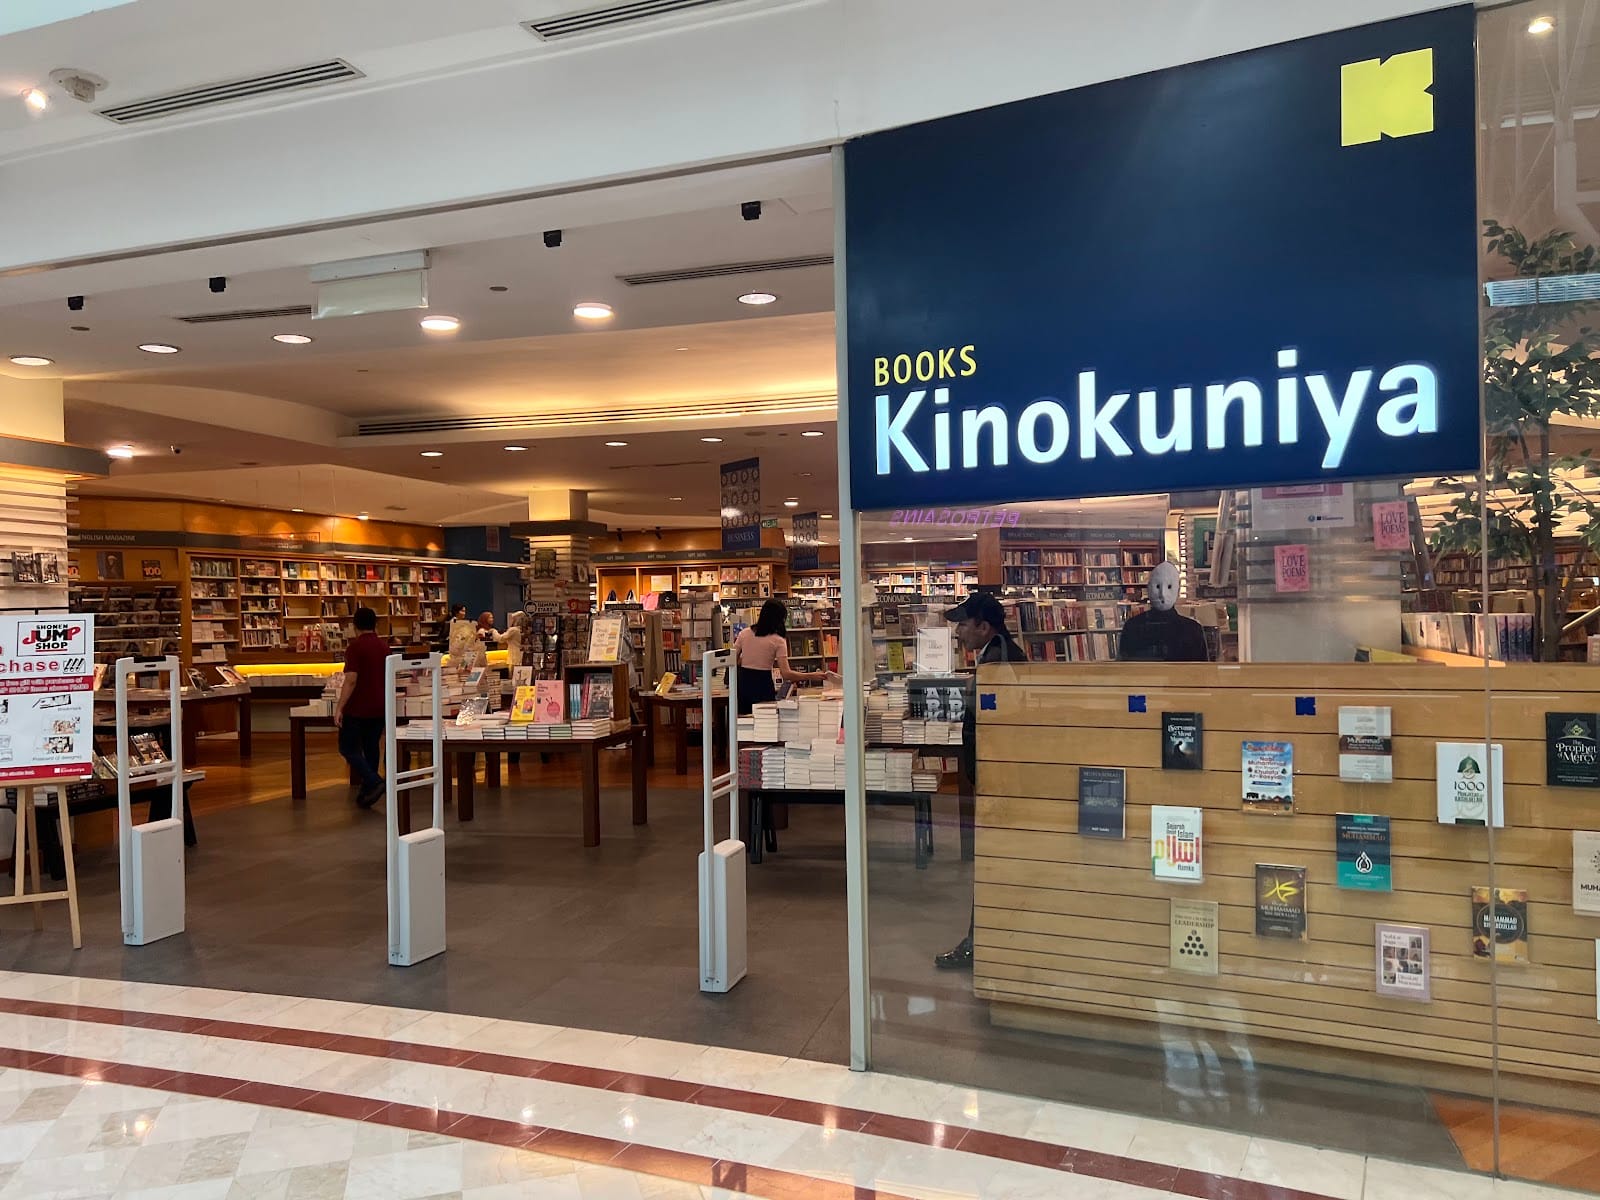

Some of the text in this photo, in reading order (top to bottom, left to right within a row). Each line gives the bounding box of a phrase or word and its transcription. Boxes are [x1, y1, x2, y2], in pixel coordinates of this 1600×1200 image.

[874, 345, 977, 386] BOOKS
[875, 349, 1438, 475] Kinokuniya
[1380, 511, 1405, 525] LOVE
[1381, 524, 1406, 535] POEMS
[1282, 555, 1305, 567] LOVE
[1282, 567, 1306, 578] POEMS
[877, 594, 911, 603] ECONOMICS
[22, 626, 81, 645] JUMP
[35, 642, 68, 650] SHOP
[1555, 743, 1598, 754] Prophet
[1563, 751, 1597, 764] Mercy
[1455, 781, 1485, 791] 1000
[1178, 829, 1194, 838] Islam
[1174, 919, 1215, 929] LEADERSHIP
